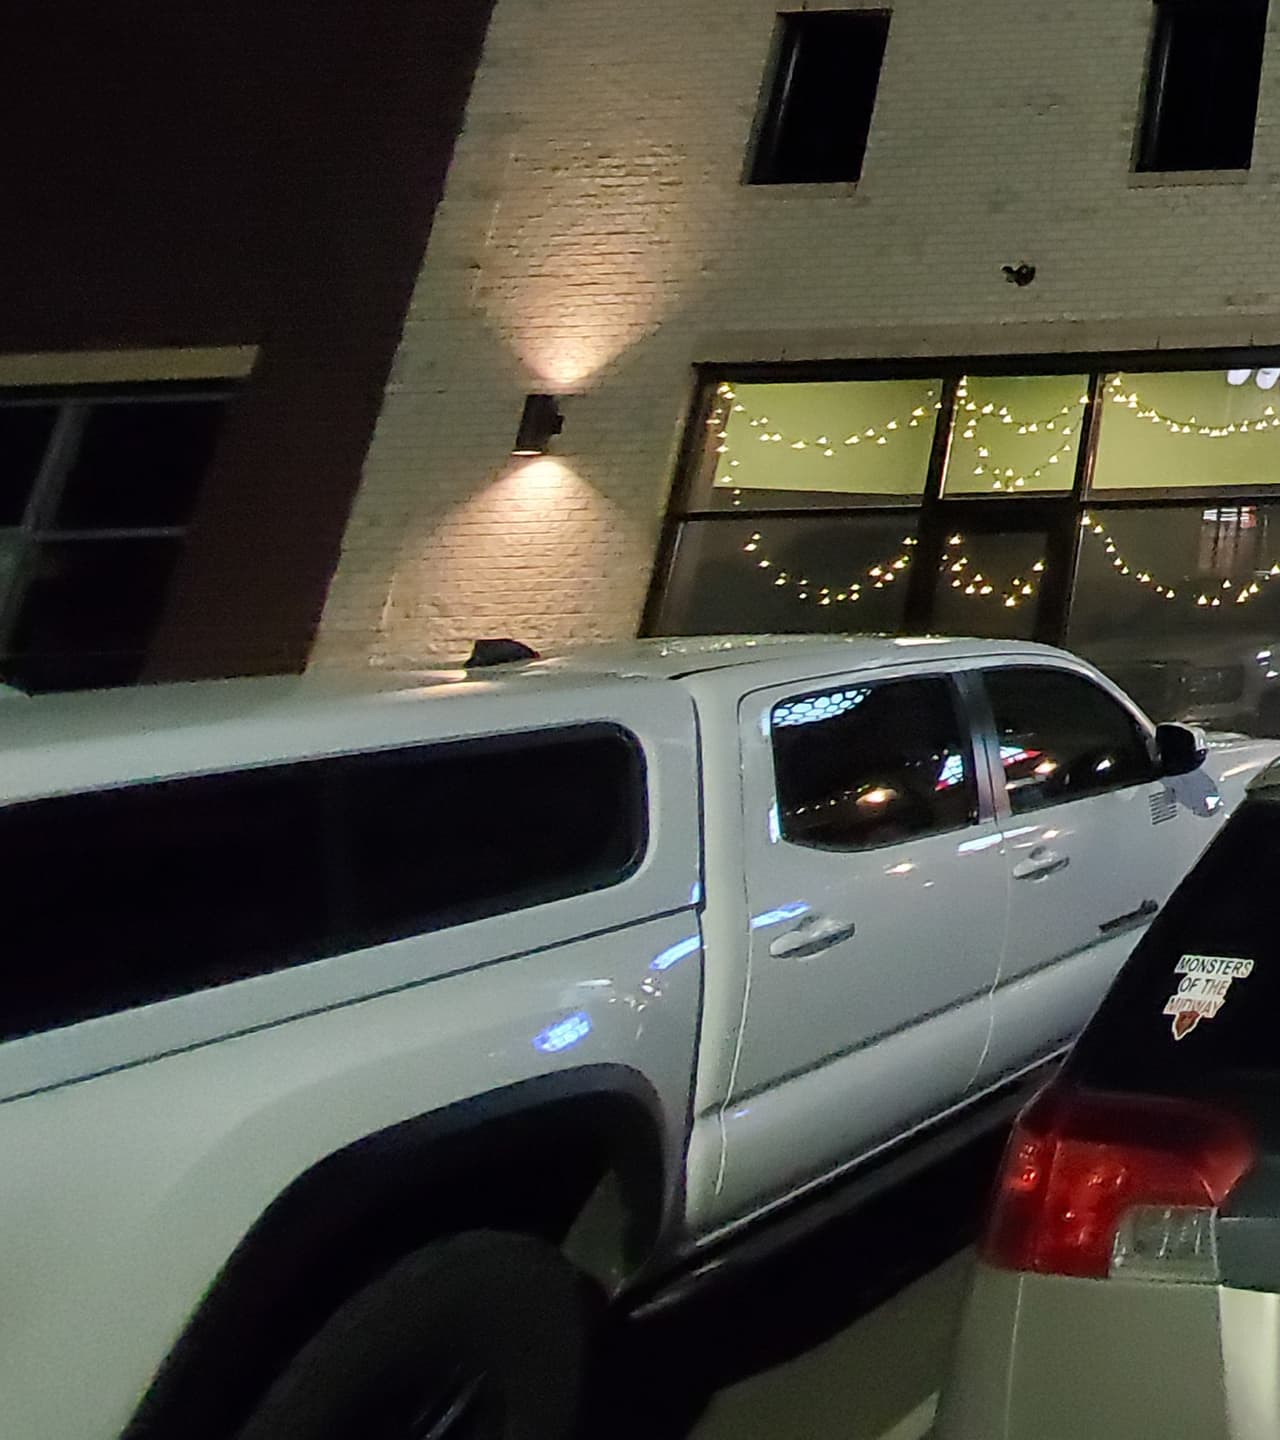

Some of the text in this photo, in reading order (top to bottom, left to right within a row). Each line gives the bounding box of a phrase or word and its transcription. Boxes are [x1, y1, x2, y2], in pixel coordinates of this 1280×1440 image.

[1179, 957, 1252, 976] MONSTERS
[1180, 977, 1229, 996] OF THE
